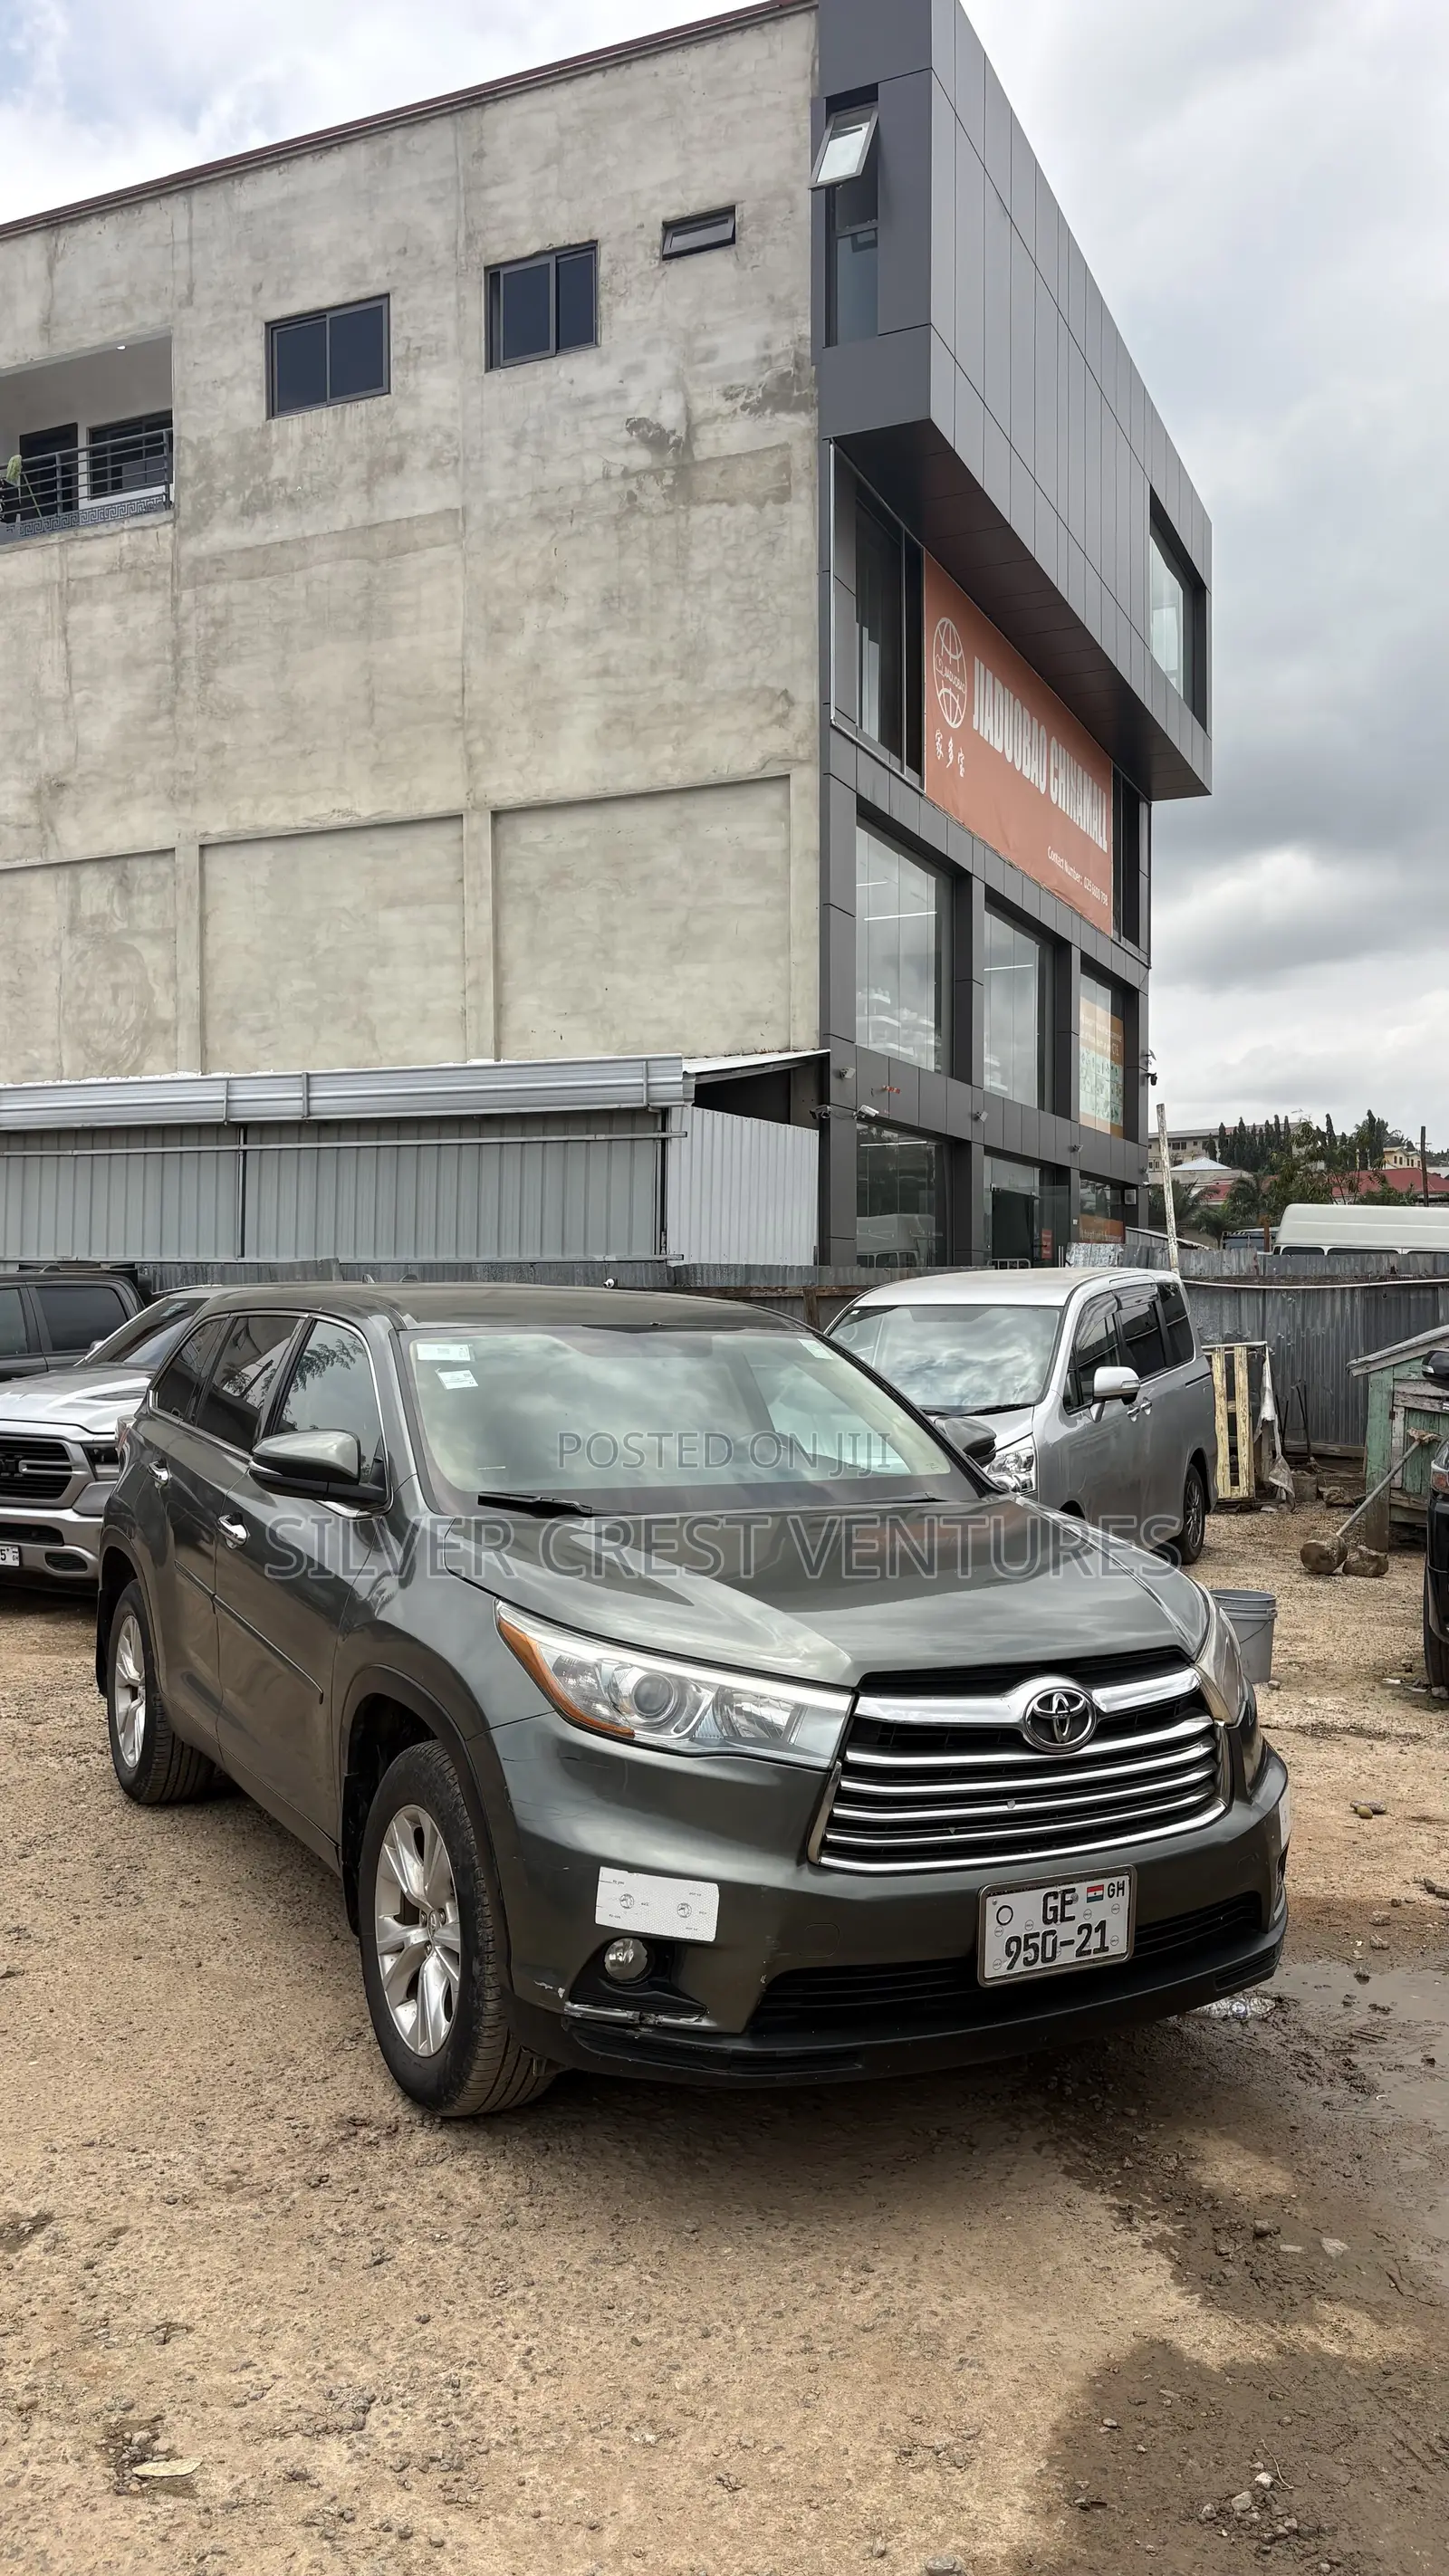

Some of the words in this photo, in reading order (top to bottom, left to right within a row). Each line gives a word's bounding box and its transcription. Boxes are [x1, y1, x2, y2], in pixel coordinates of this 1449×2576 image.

[974, 656, 1047, 794] JIADUOBAO
[1050, 736, 1108, 853] CHINAMALL
[1047, 846, 1064, 869] Contact
[1042, 1888, 1076, 1925] GE
[1108, 1880, 1125, 1899] GH
[1004, 1920, 1109, 1970] 950-21
